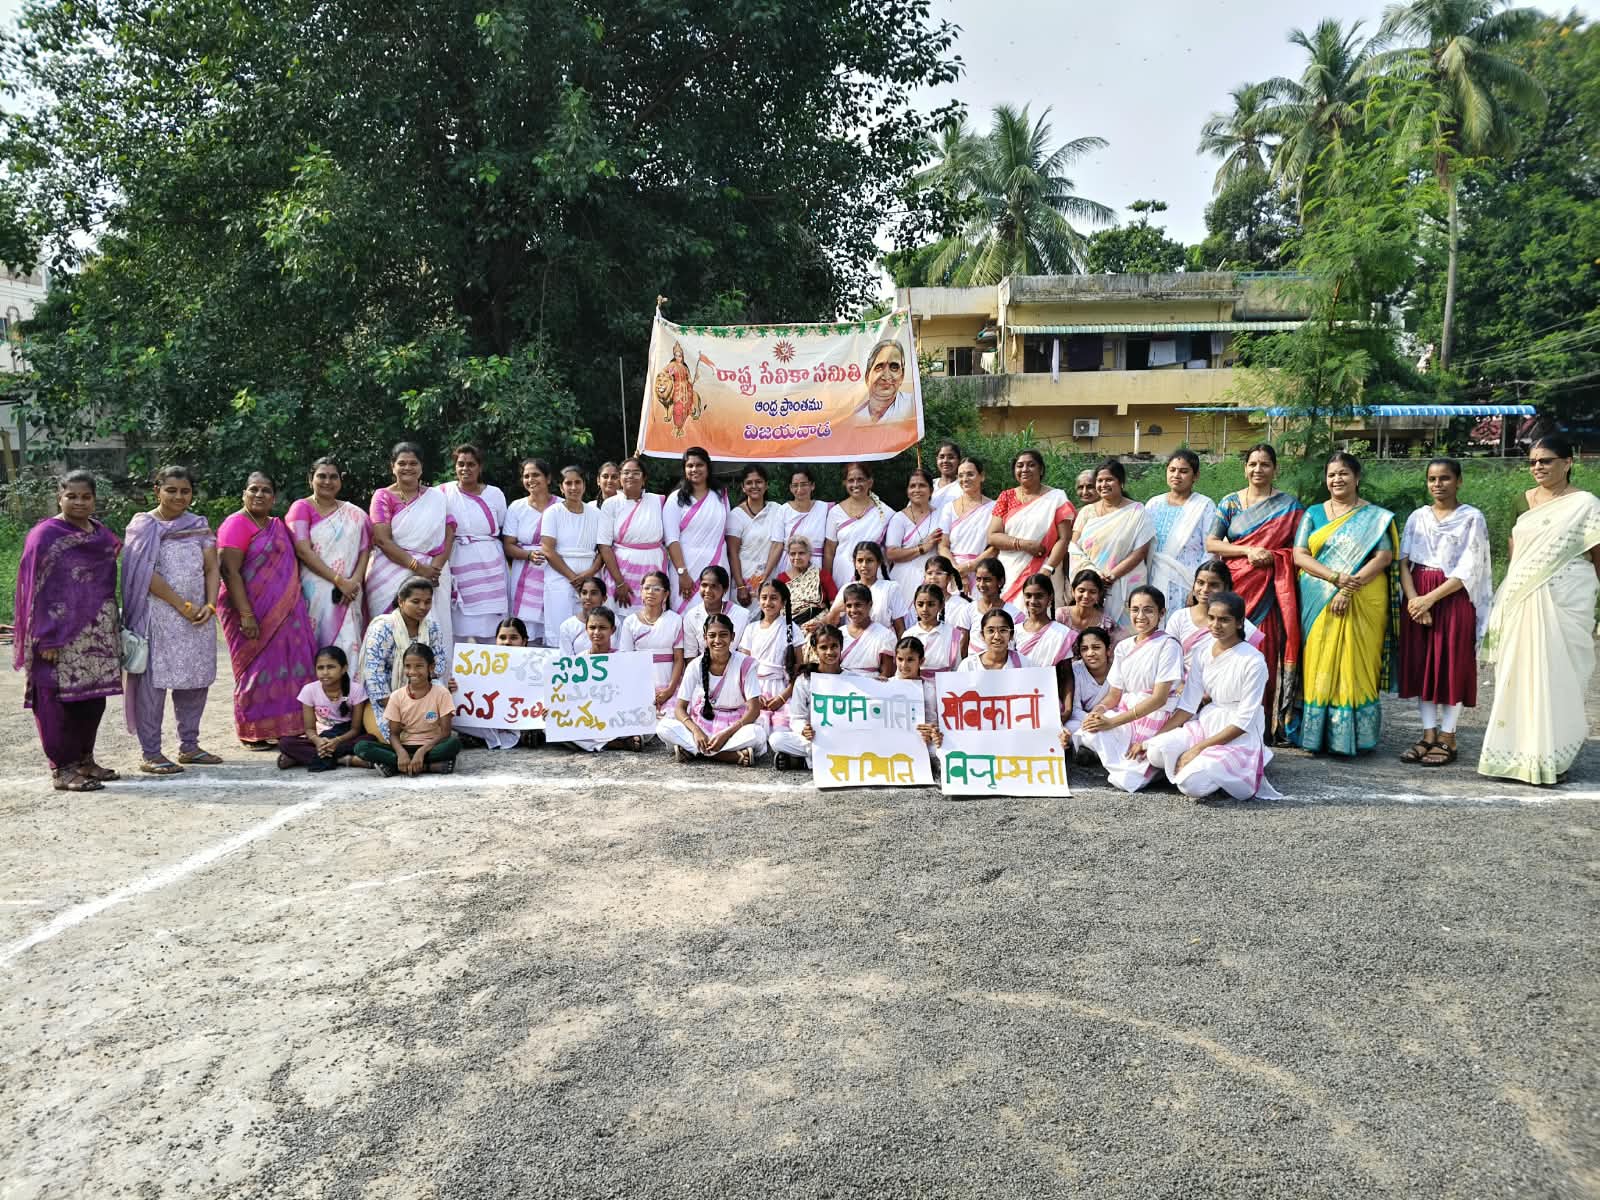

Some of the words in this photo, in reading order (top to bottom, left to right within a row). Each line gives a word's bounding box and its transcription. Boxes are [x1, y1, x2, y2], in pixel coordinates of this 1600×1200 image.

[759, 361, 810, 385] సేవికా
[813, 362, 862, 383] సమితి
[744, 421, 832, 439] విజయవాడ
[455, 689, 501, 720] నవ
[825, 751, 915, 783] समिति
